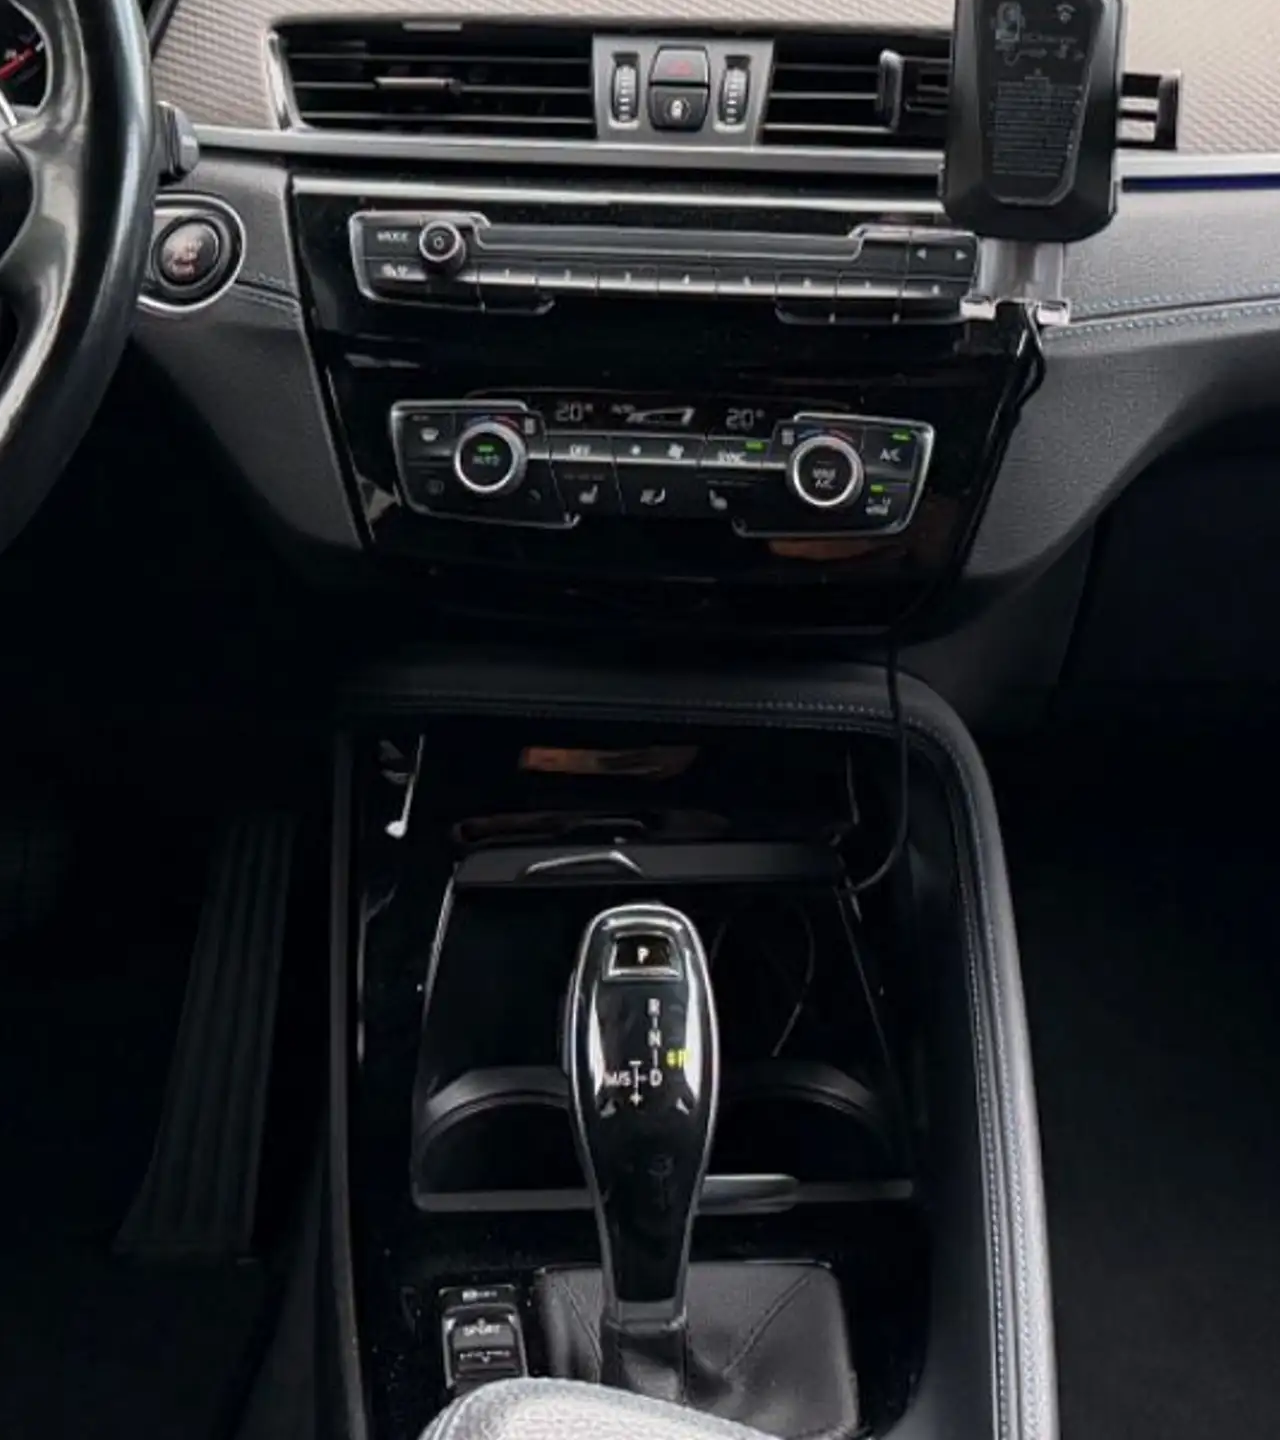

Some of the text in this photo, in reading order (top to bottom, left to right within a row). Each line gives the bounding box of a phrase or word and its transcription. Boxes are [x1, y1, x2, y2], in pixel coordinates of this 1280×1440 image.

[637, 946, 650, 963] P
[648, 1029, 661, 1047] N
[650, 1068, 662, 1087] D
